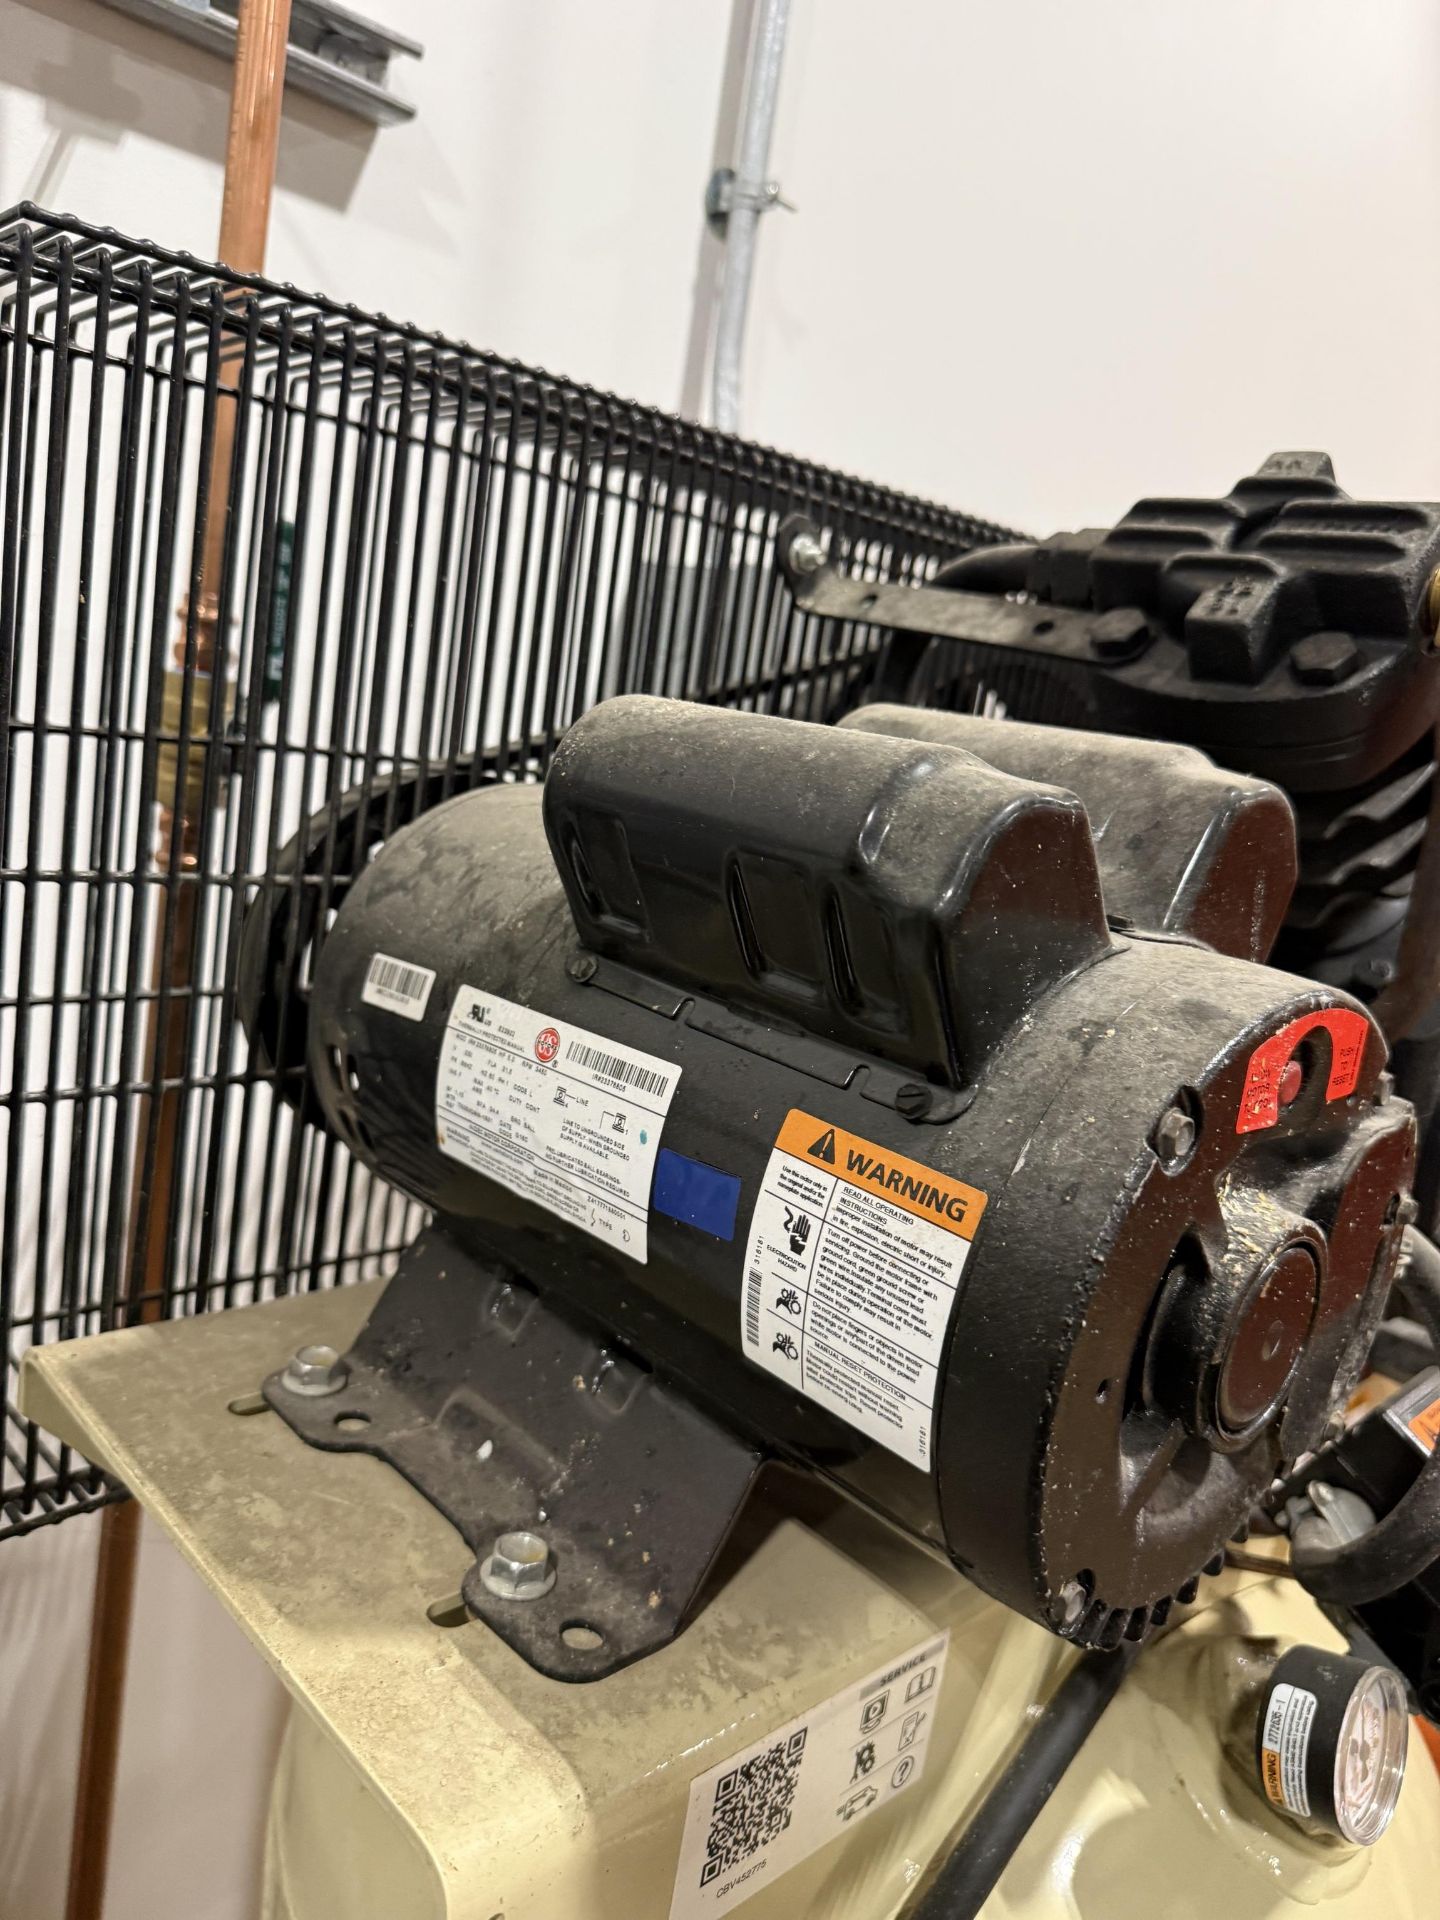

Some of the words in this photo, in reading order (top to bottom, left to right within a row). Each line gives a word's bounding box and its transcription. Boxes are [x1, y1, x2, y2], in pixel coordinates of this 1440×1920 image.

[575, 1096, 588, 1106] LINE
[839, 1196, 887, 1224] INSTRUCTIONS
[843, 1186, 861, 1199] READ
[863, 1195, 873, 1206] ALL
[875, 1202, 913, 1225] OPERATING
[846, 1149, 967, 1222] WARNING
[827, 1227, 840, 1239] Turn
[841, 1236, 850, 1244] off
[848, 1240, 867, 1253] power
[868, 1249, 887, 1264] before
[888, 1261, 921, 1283] connecting
[835, 1205, 861, 1222] Improper
[861, 1219, 892, 1238] installation
[900, 1238, 918, 1251] motor
[918, 1248, 933, 1259] may
[933, 1255, 952, 1268] result
[850, 1225, 879, 1244] explosion,
[880, 1240, 902, 1254] electric
[903, 1251, 919, 1263] short
[820, 1254, 837, 1266] green
[874, 1283, 885, 1294] any
[886, 1289, 909, 1306] unused
[909, 1301, 924, 1313] lead
[822, 1246, 843, 1260] ground
[842, 1257, 856, 1269] cord,
[858, 1265, 875, 1277] green
[876, 1275, 897, 1289] ground
[898, 1287, 916, 1299] screw
[824, 1237, 850, 1255] servicing.
[852, 1251, 874, 1267] Ground
[875, 1263, 884, 1272] the
[885, 1269, 903, 1281] motor
[904, 1278, 922, 1292] frame
[814, 1288, 833, 1302] serious
[815, 1278, 834, 1293] Failure
[842, 1294, 862, 1310] comply
[863, 1306, 876, 1317] may
[876, 1314, 894, 1327] result
[894, 1323, 900, 1331] in
[816, 1270, 824, 1278] be
[831, 1279, 847, 1291] place
[847, 1288, 866, 1303] during
[866, 1299, 894, 1317] operation
[902, 1318, 913, 1328] the
[818, 1263, 833, 1274] wires
[892, 1304, 909, 1316] cover
[910, 1313, 927, 1325] must
[810, 1318, 824, 1329] while
[825, 1326, 841, 1339] motor
[848, 1340, 879, 1362] connected
[886, 1362, 896, 1372] the
[896, 1369, 916, 1383] power
[811, 1309, 836, 1327] openings
[875, 1346, 885, 1356] the
[886, 1353, 904, 1367] driven
[905, 1364, 919, 1376] load
[812, 1300, 821, 1310] Do
[821, 1306, 832, 1315] not
[831, 1312, 847, 1325] place
[847, 1321, 867, 1336] fingers
[875, 1338, 897, 1354] objects
[897, 1350, 904, 1358] in
[904, 1355, 923, 1368] motor
[863, 1370, 905, 1400] PROTECTION
[880, 1654, 927, 1686] SERVICE
[716, 1859, 767, 1898] CBV452775
